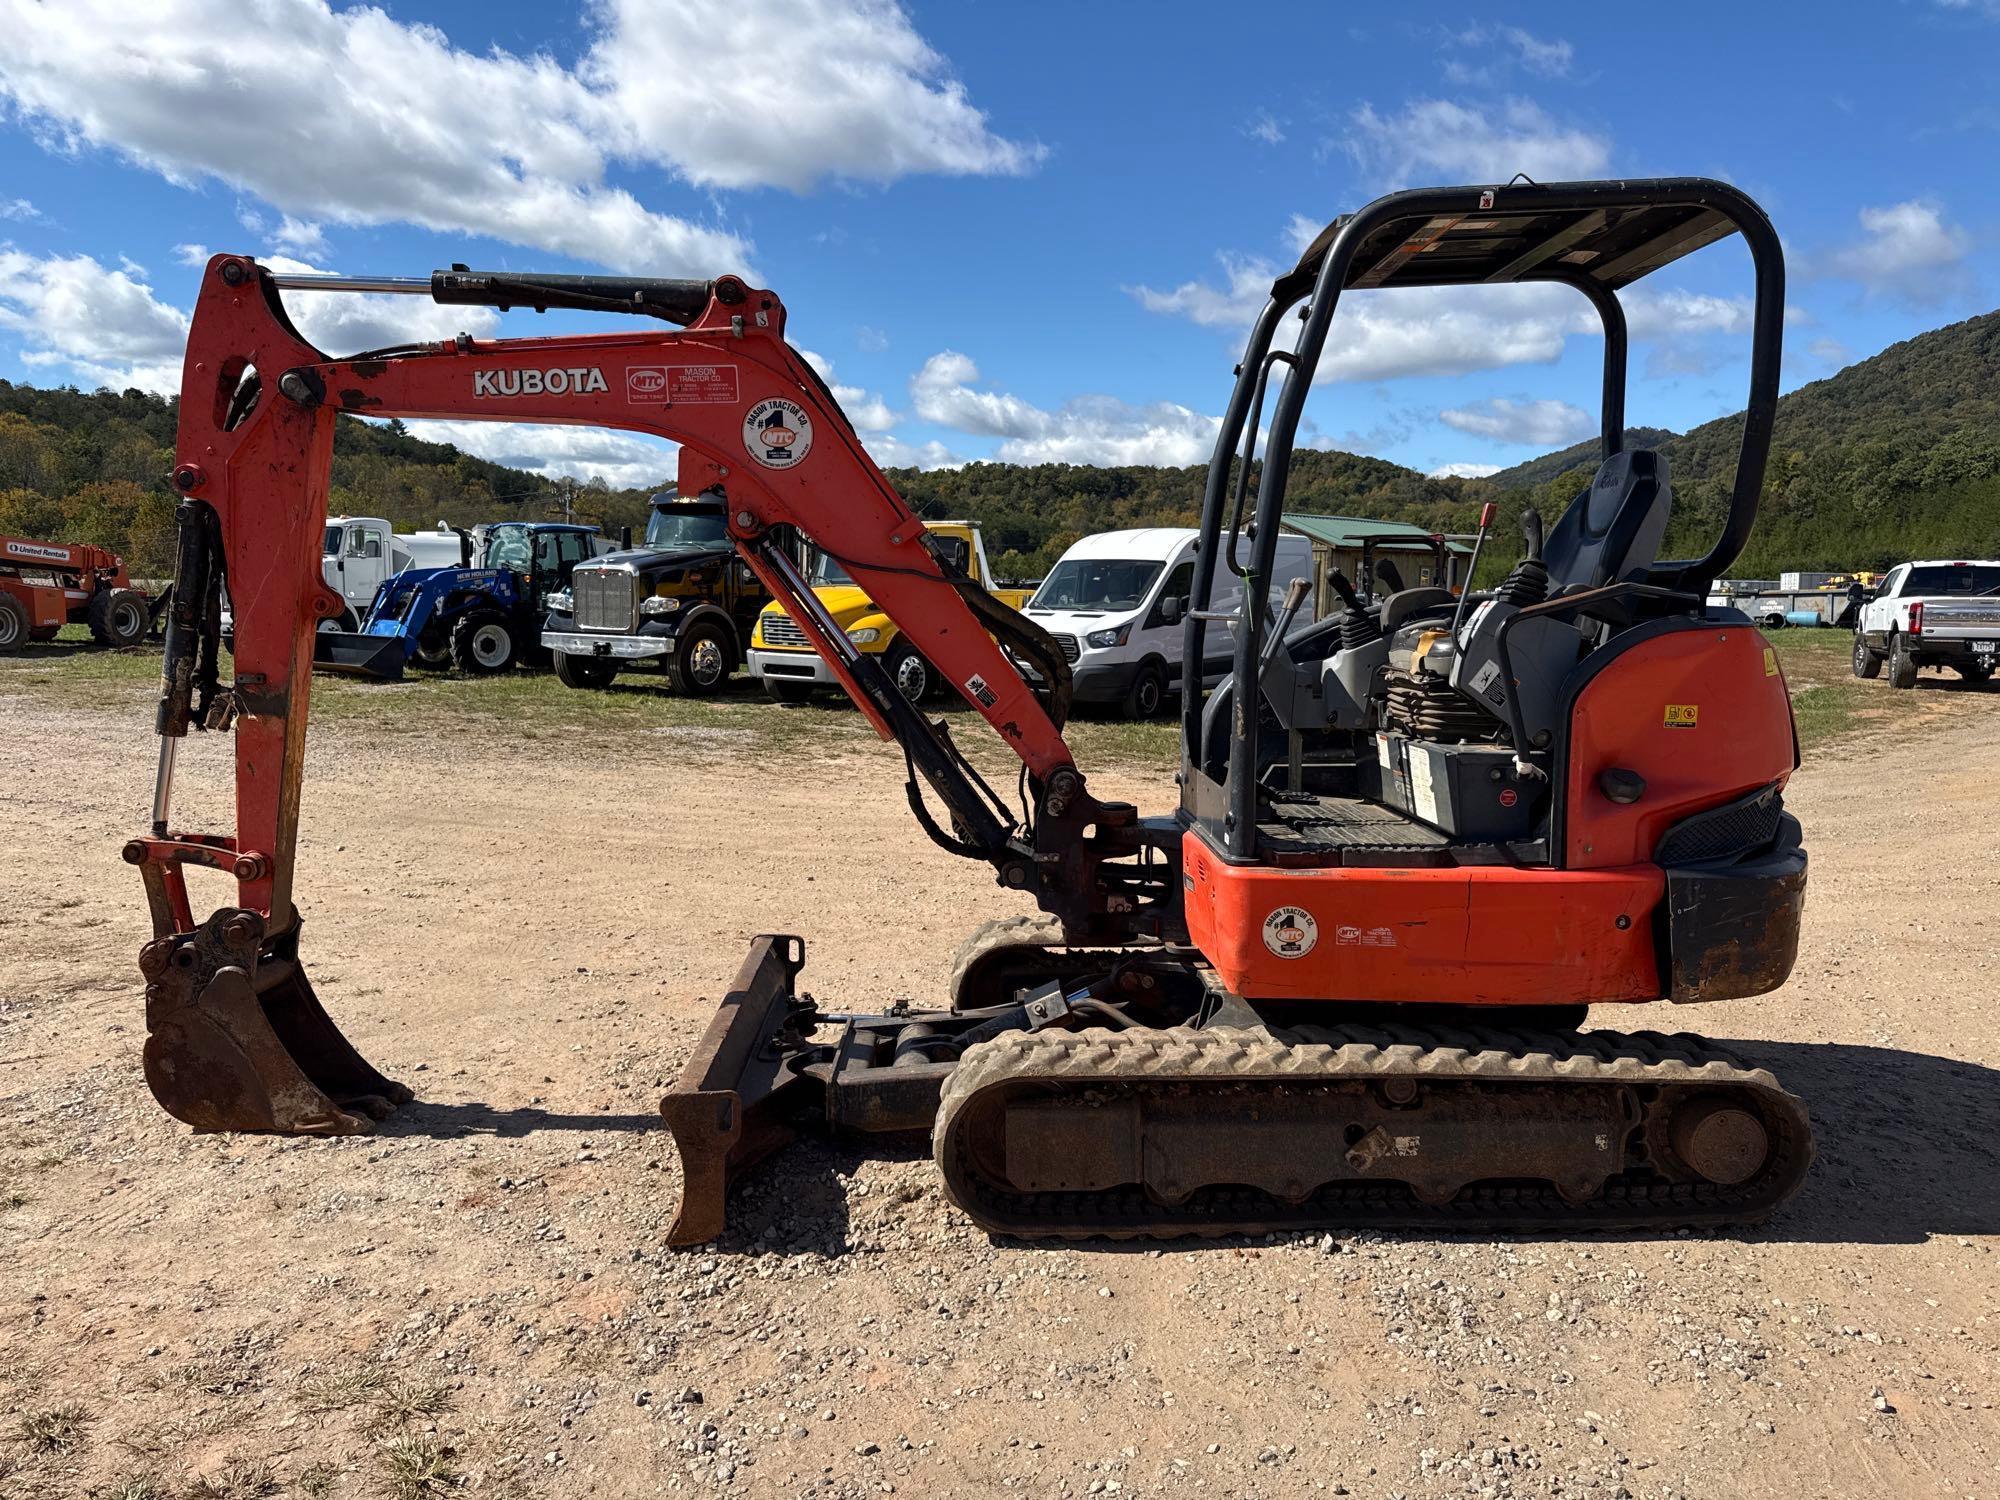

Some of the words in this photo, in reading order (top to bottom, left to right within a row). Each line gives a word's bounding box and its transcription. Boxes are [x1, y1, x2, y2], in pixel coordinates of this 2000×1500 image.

[684, 367, 716, 376] MASON
[474, 367, 609, 395] KUBOTA
[747, 404, 768, 426] MASON
[768, 401, 800, 416] TRACTOR
[19, 545, 42, 556] United
[42, 549, 67, 559] Rentals
[457, 572, 471, 580] NEW
[471, 570, 498, 578] HOLLAND
[1266, 911, 1282, 927] MASON
[1283, 908, 1308, 919] TRACTOR
